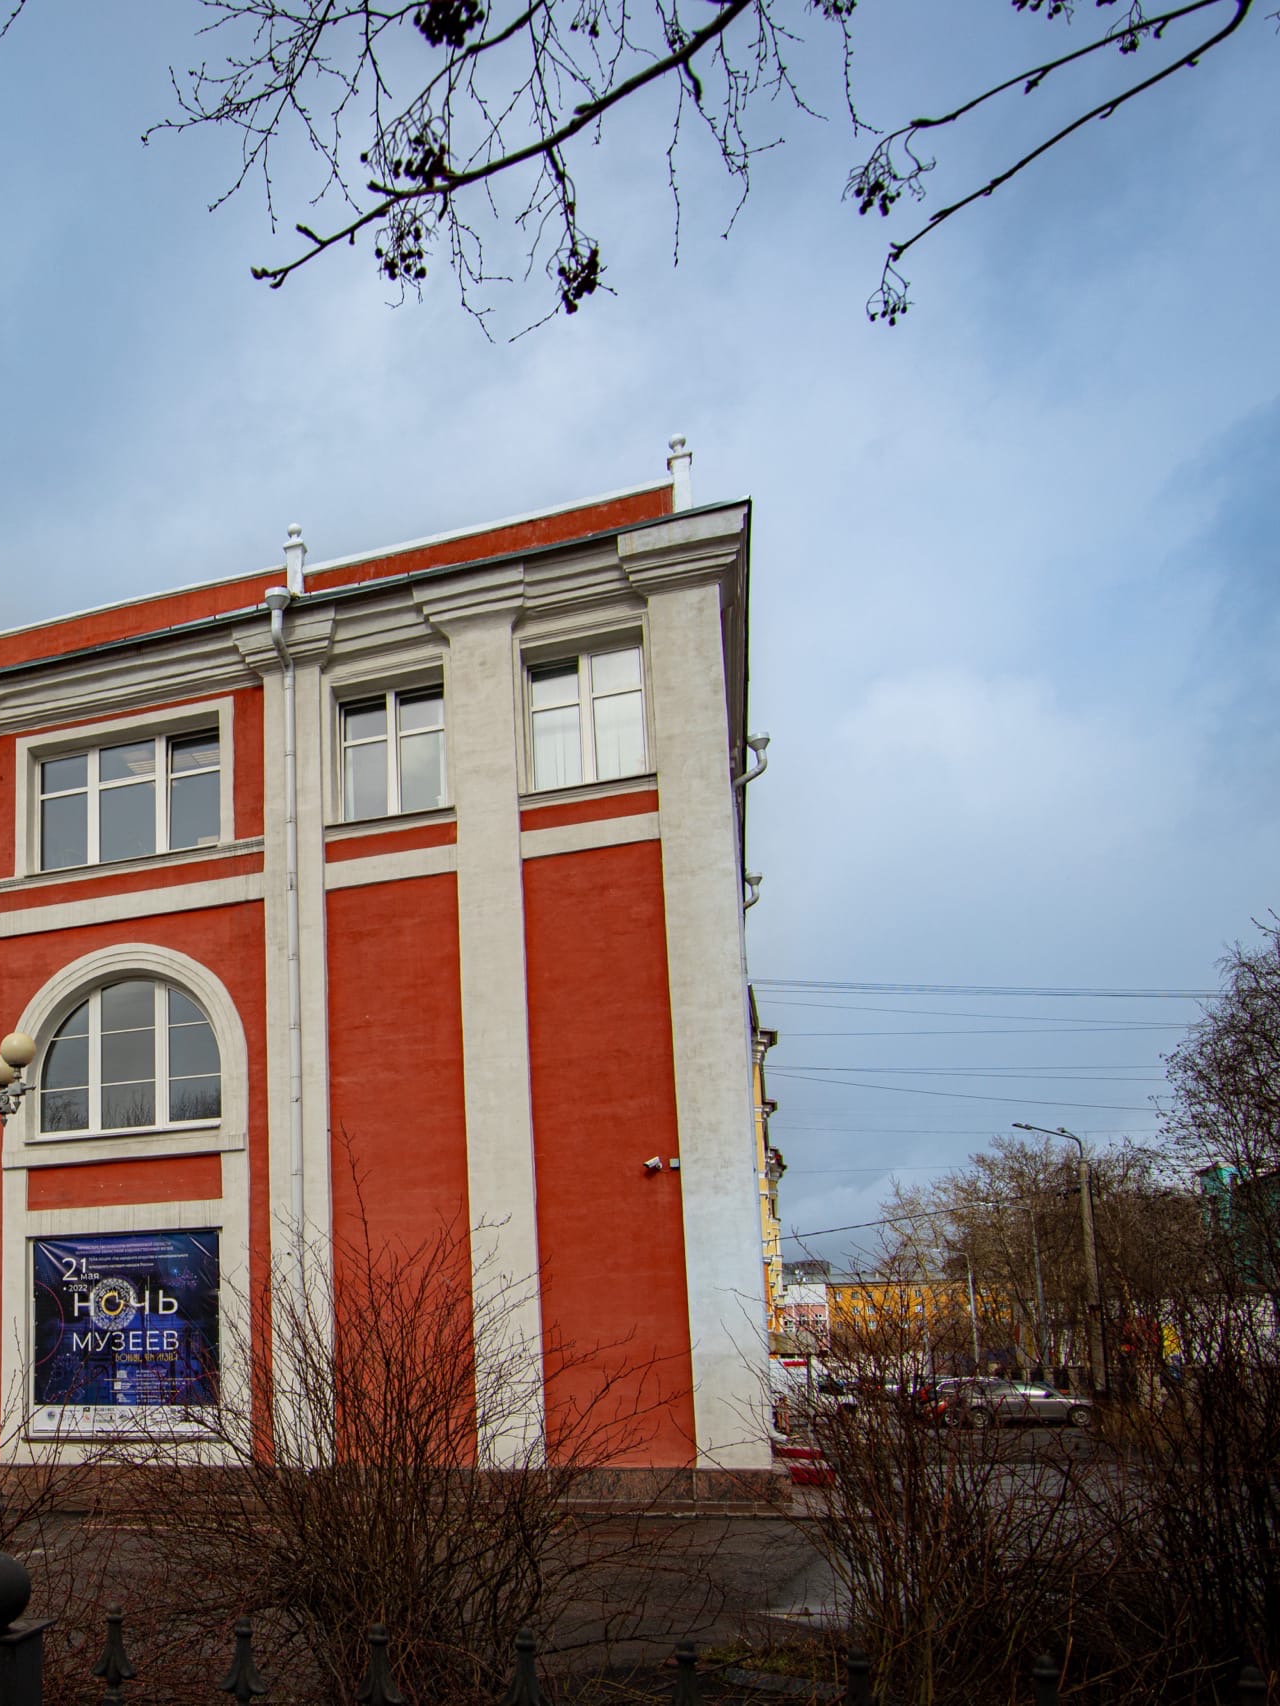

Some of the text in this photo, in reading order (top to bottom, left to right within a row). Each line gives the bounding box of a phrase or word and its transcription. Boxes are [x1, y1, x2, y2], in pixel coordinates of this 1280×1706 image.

[61, 1257, 86, 1281] 21
[68, 1284, 88, 1292] 2022
[73, 1290, 178, 1317] НОЧЬ
[72, 1330, 179, 1352] МУЗЕЕВ
